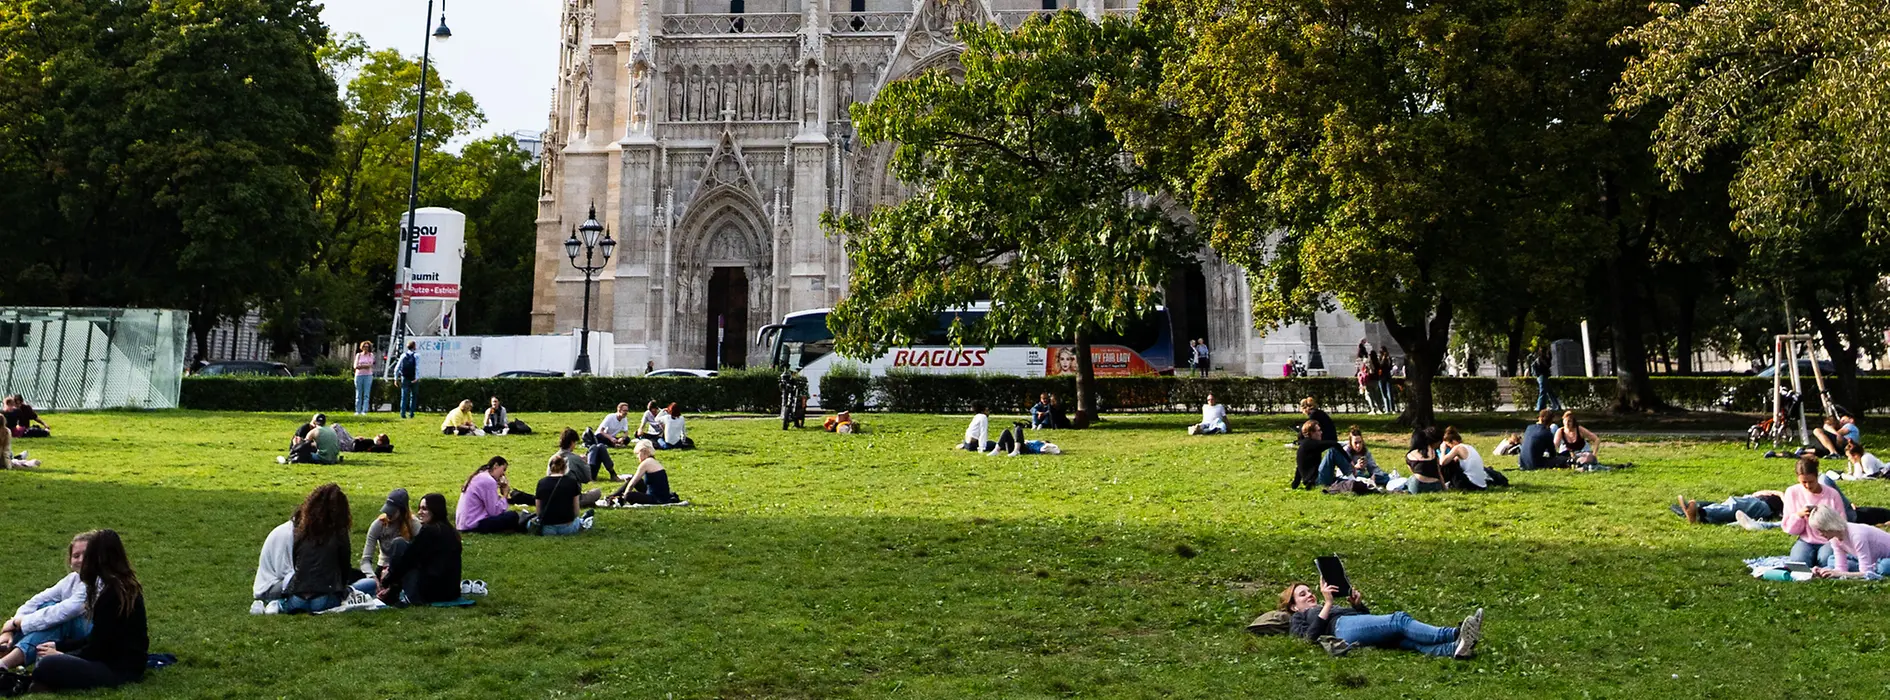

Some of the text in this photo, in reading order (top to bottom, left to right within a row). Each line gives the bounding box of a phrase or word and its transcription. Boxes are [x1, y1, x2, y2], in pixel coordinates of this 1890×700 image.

[411, 272, 440, 281] aumit
[894, 350, 987, 367] BLAGUSS
[1103, 352, 1116, 363] FAIR
[1117, 352, 1131, 363] LADY
